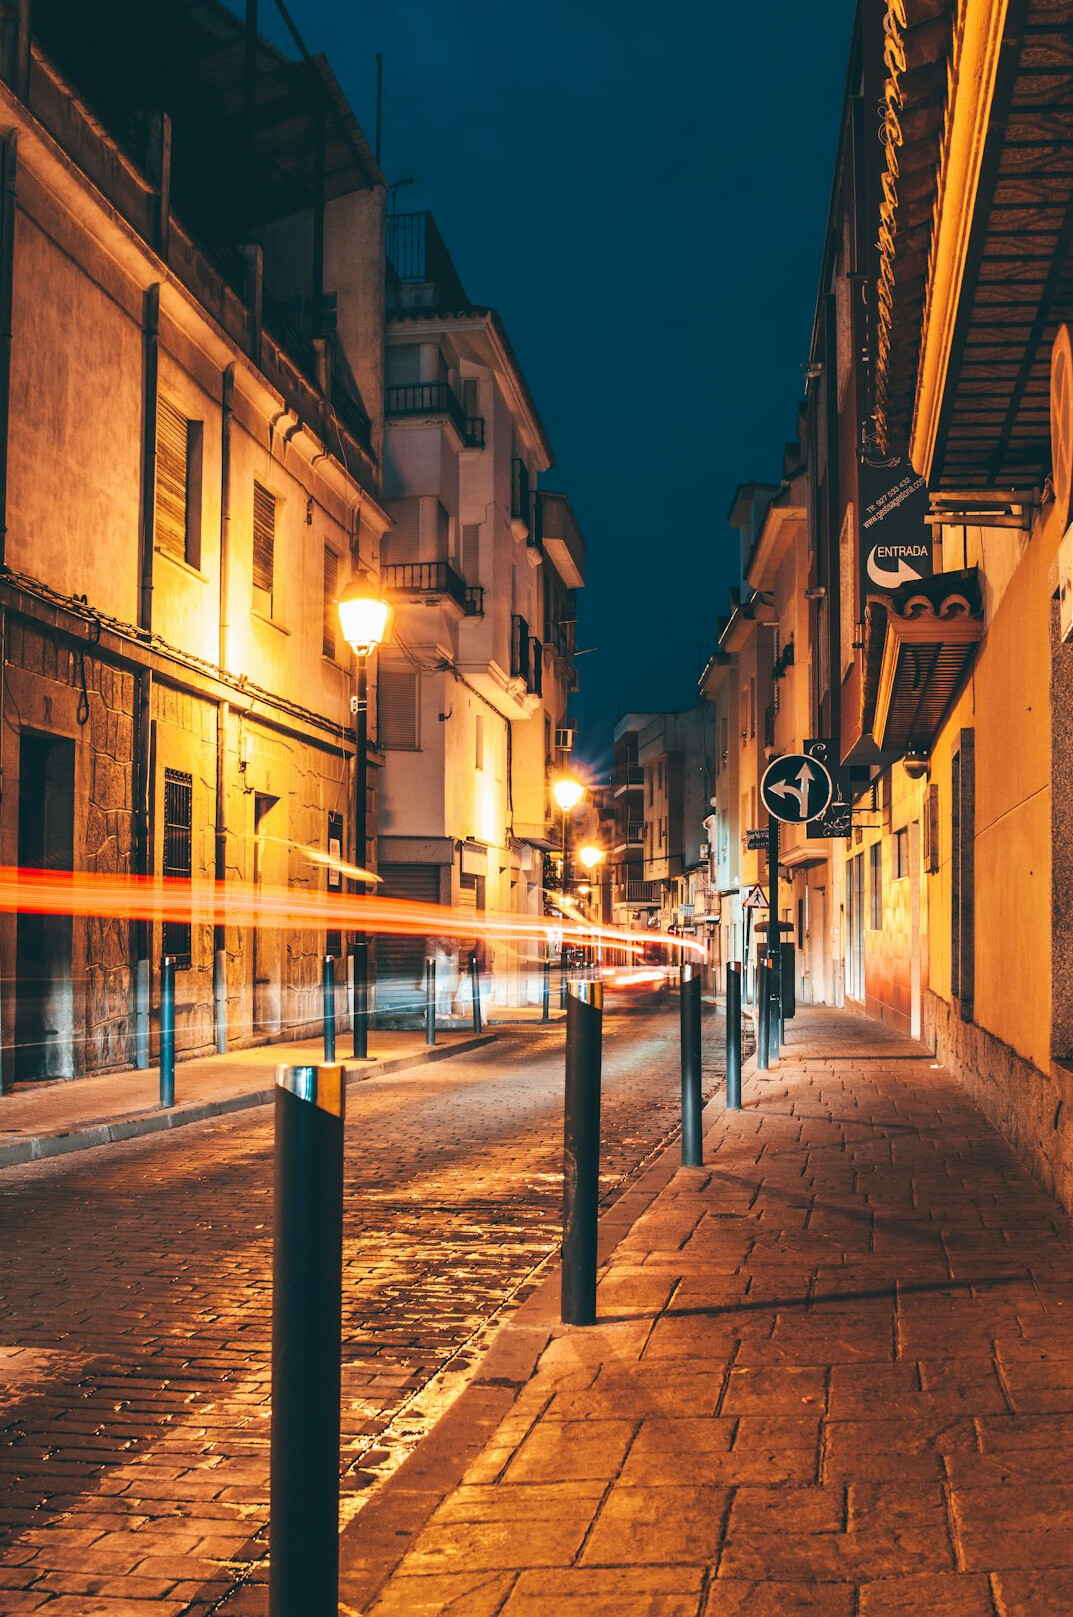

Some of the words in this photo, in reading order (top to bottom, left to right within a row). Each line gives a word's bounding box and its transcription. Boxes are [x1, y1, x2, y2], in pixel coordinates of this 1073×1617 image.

[876, 495, 887, 506] 927
[899, 477, 911, 487] 432
[877, 545, 928, 558] ENTRADA
